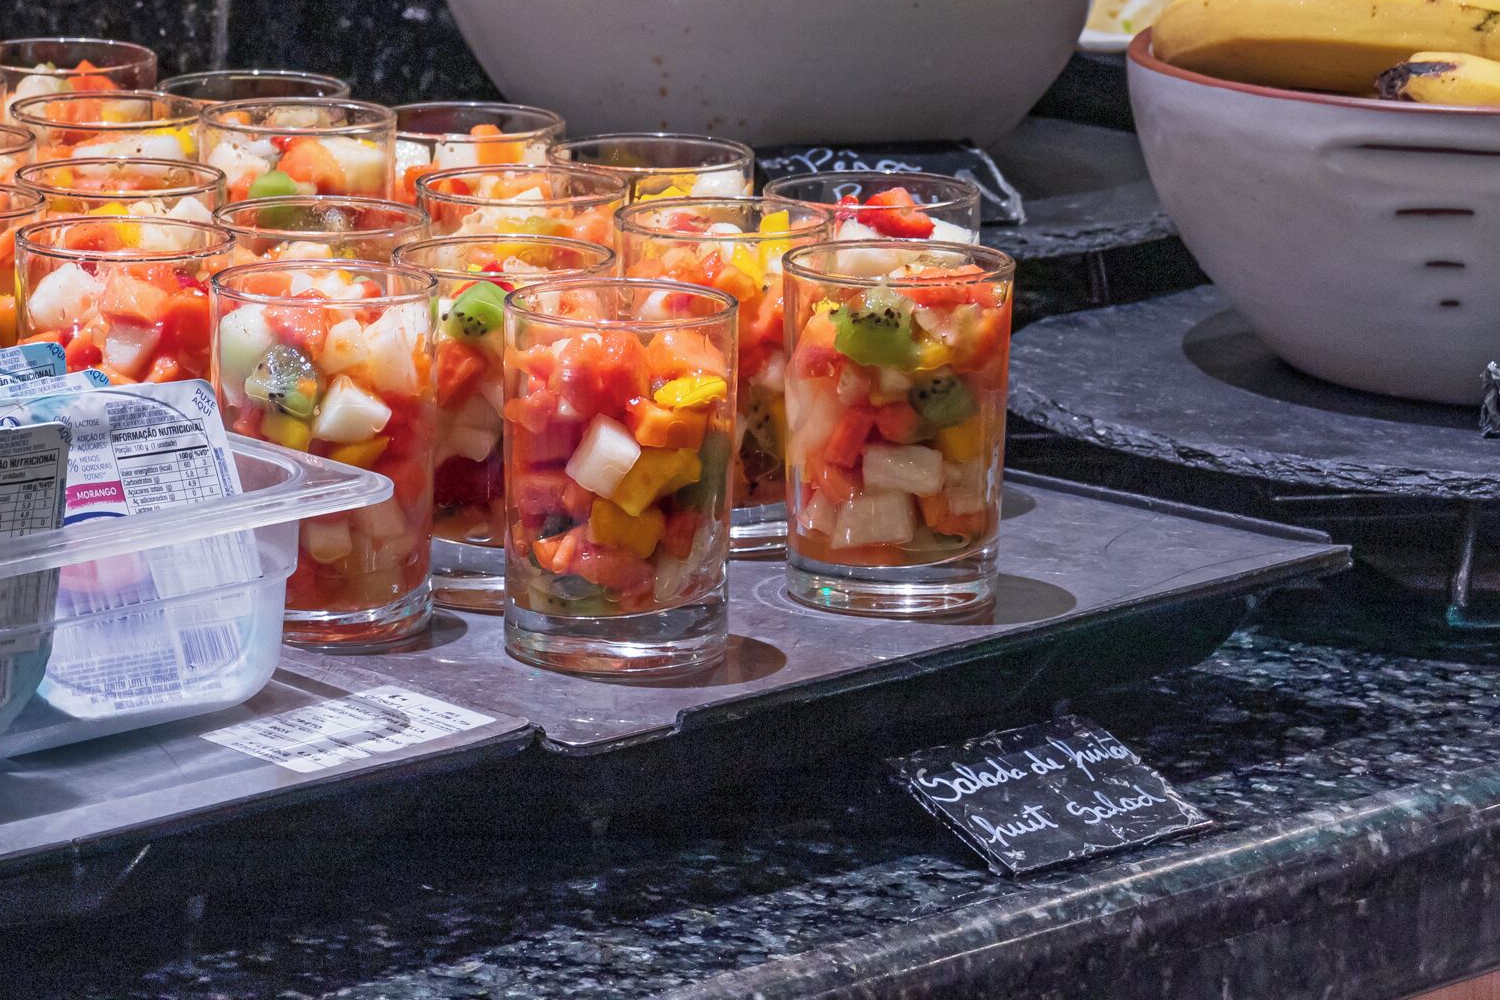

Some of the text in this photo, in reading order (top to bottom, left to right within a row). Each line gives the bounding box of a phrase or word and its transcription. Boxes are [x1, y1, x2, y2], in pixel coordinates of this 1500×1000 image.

[192, 396, 212, 417] AQUI
[194, 387, 217, 411] PUXE
[74, 417, 100, 428] LACTOSE
[76, 432, 107, 442] ADIÇÃO DE
[112, 422, 204, 443] INFORMAÇÃO NUTRICIONAL
[9, 452, 56, 468] NUTRICIONAL
[79, 454, 100, 463] MENOS
[81, 461, 113, 473] GORDURAS
[76, 486, 118, 501] MORANGO
[916, 757, 1028, 803] Salada
[1024, 750, 1065, 775] de
[1066, 784, 1167, 824] Salad
